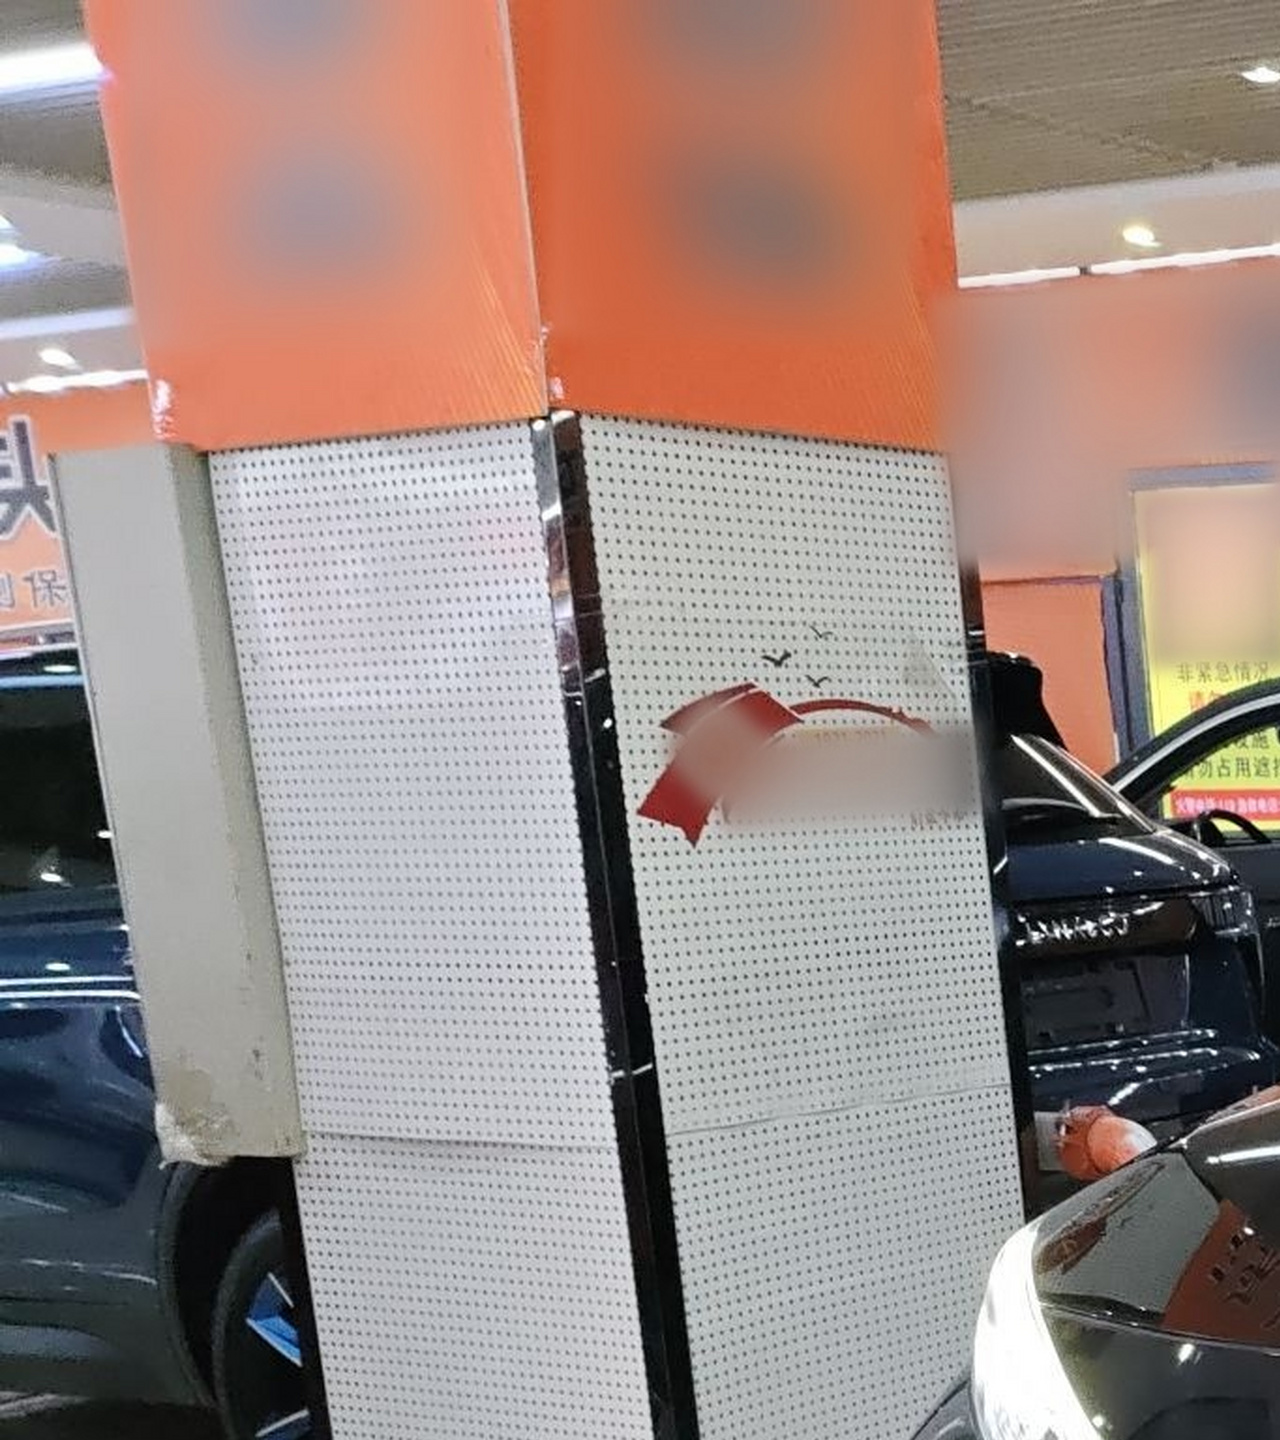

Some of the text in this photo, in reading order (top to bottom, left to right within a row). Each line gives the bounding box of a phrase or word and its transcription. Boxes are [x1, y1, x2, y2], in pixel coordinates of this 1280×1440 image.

[1176, 661, 1269, 683] 非紧急情况
